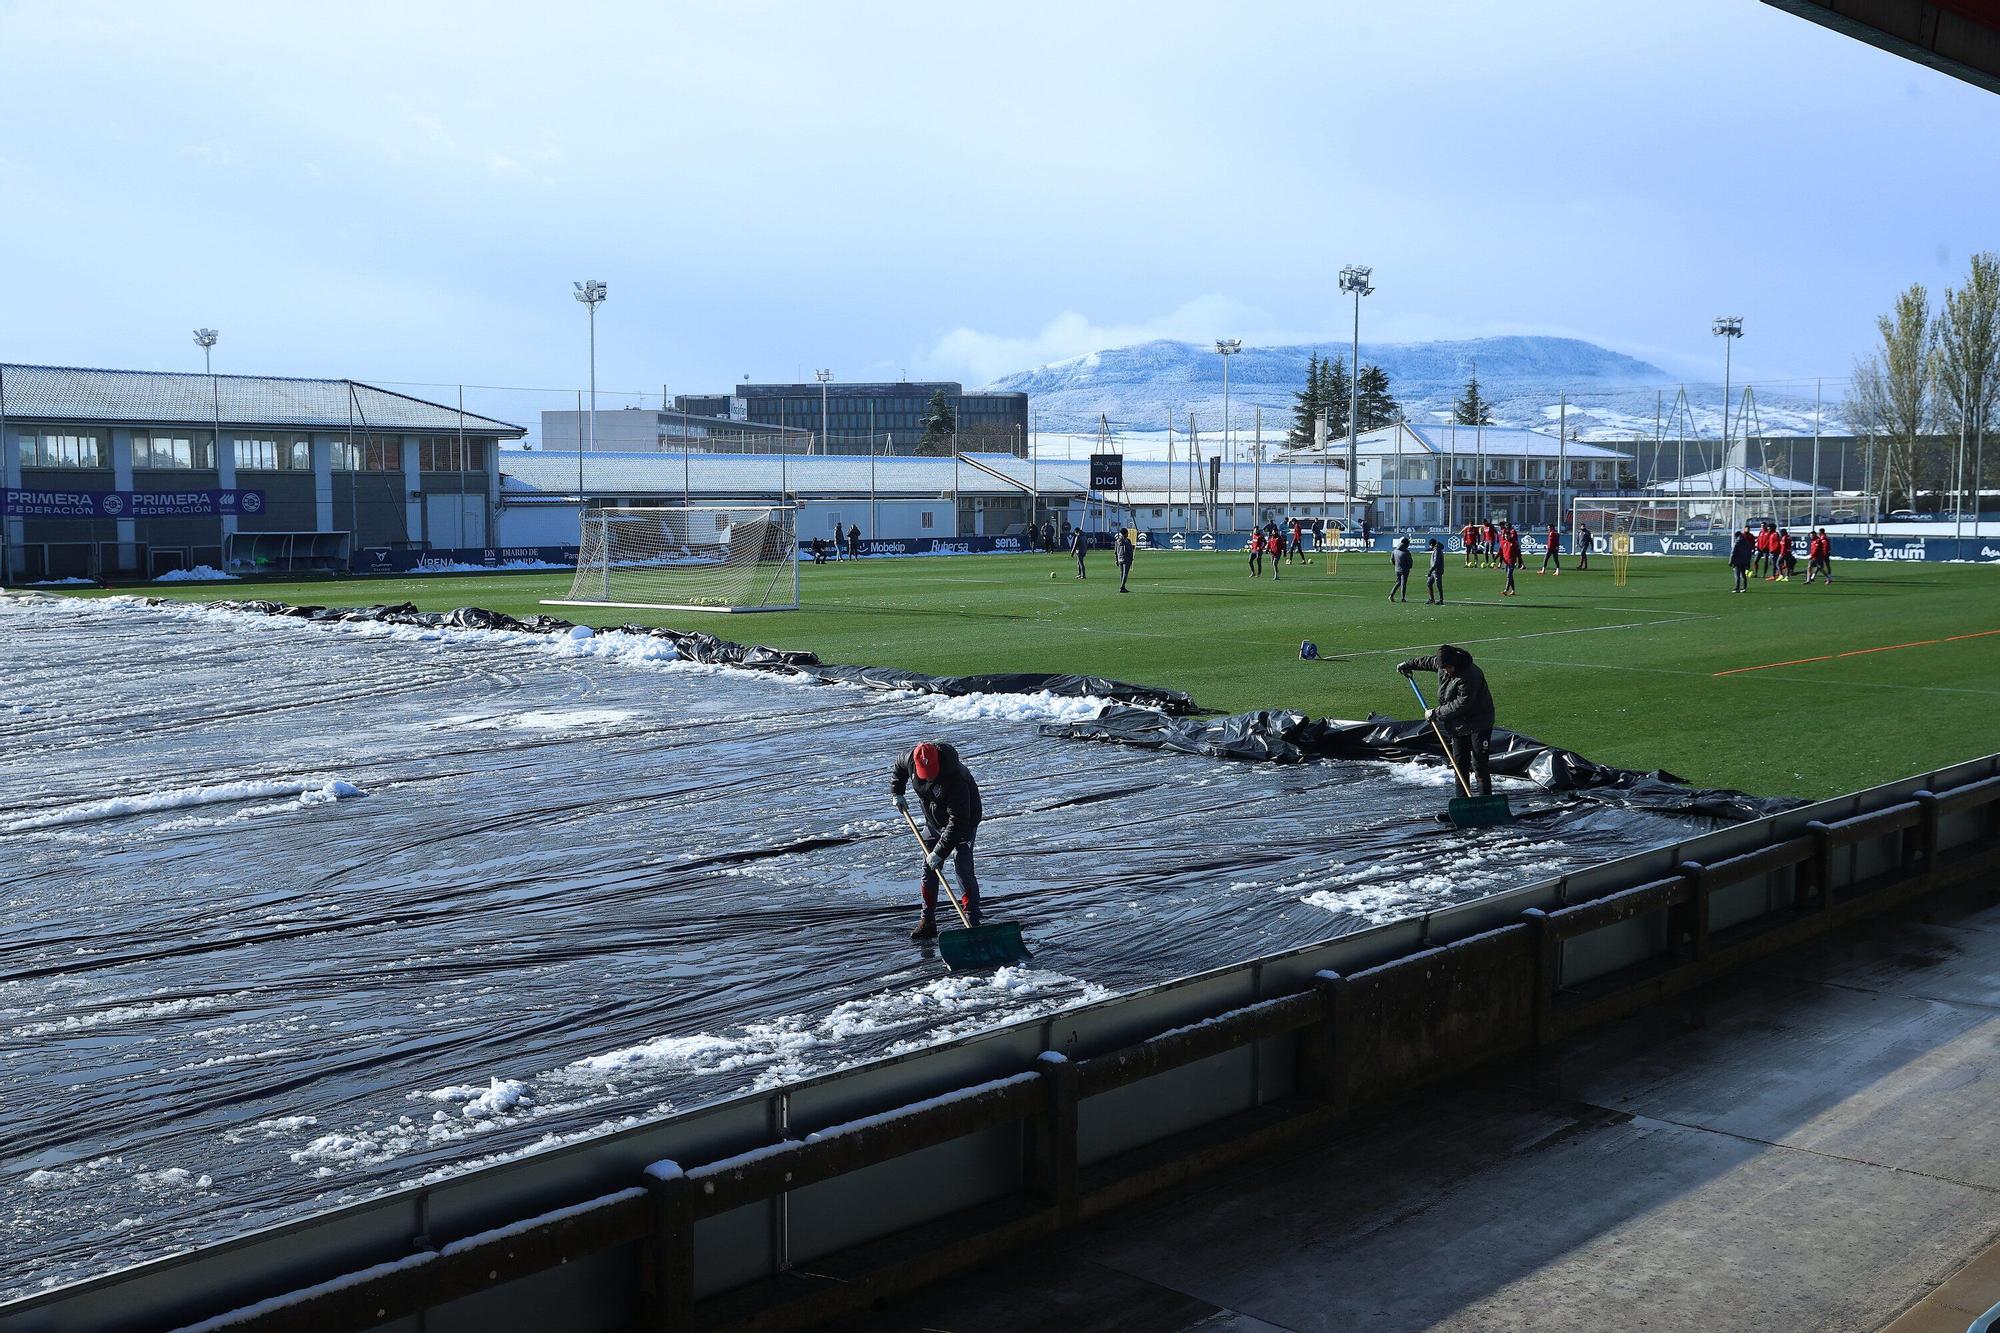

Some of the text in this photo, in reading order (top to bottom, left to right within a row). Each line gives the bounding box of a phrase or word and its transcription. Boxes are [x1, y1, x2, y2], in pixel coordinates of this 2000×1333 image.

[1095, 476, 1117, 485] DIGI
[7, 492, 93, 505] PRIMERA
[132, 493, 211, 505] PRIMERA
[7, 505, 94, 514] FEDERACIÓN
[132, 504, 212, 515] FEDERACIÓN
[870, 542, 906, 553] Mobekip
[1672, 540, 1713, 551] macron
[502, 548, 539, 557] DIARIO DE
[1874, 547, 1925, 560] axium
